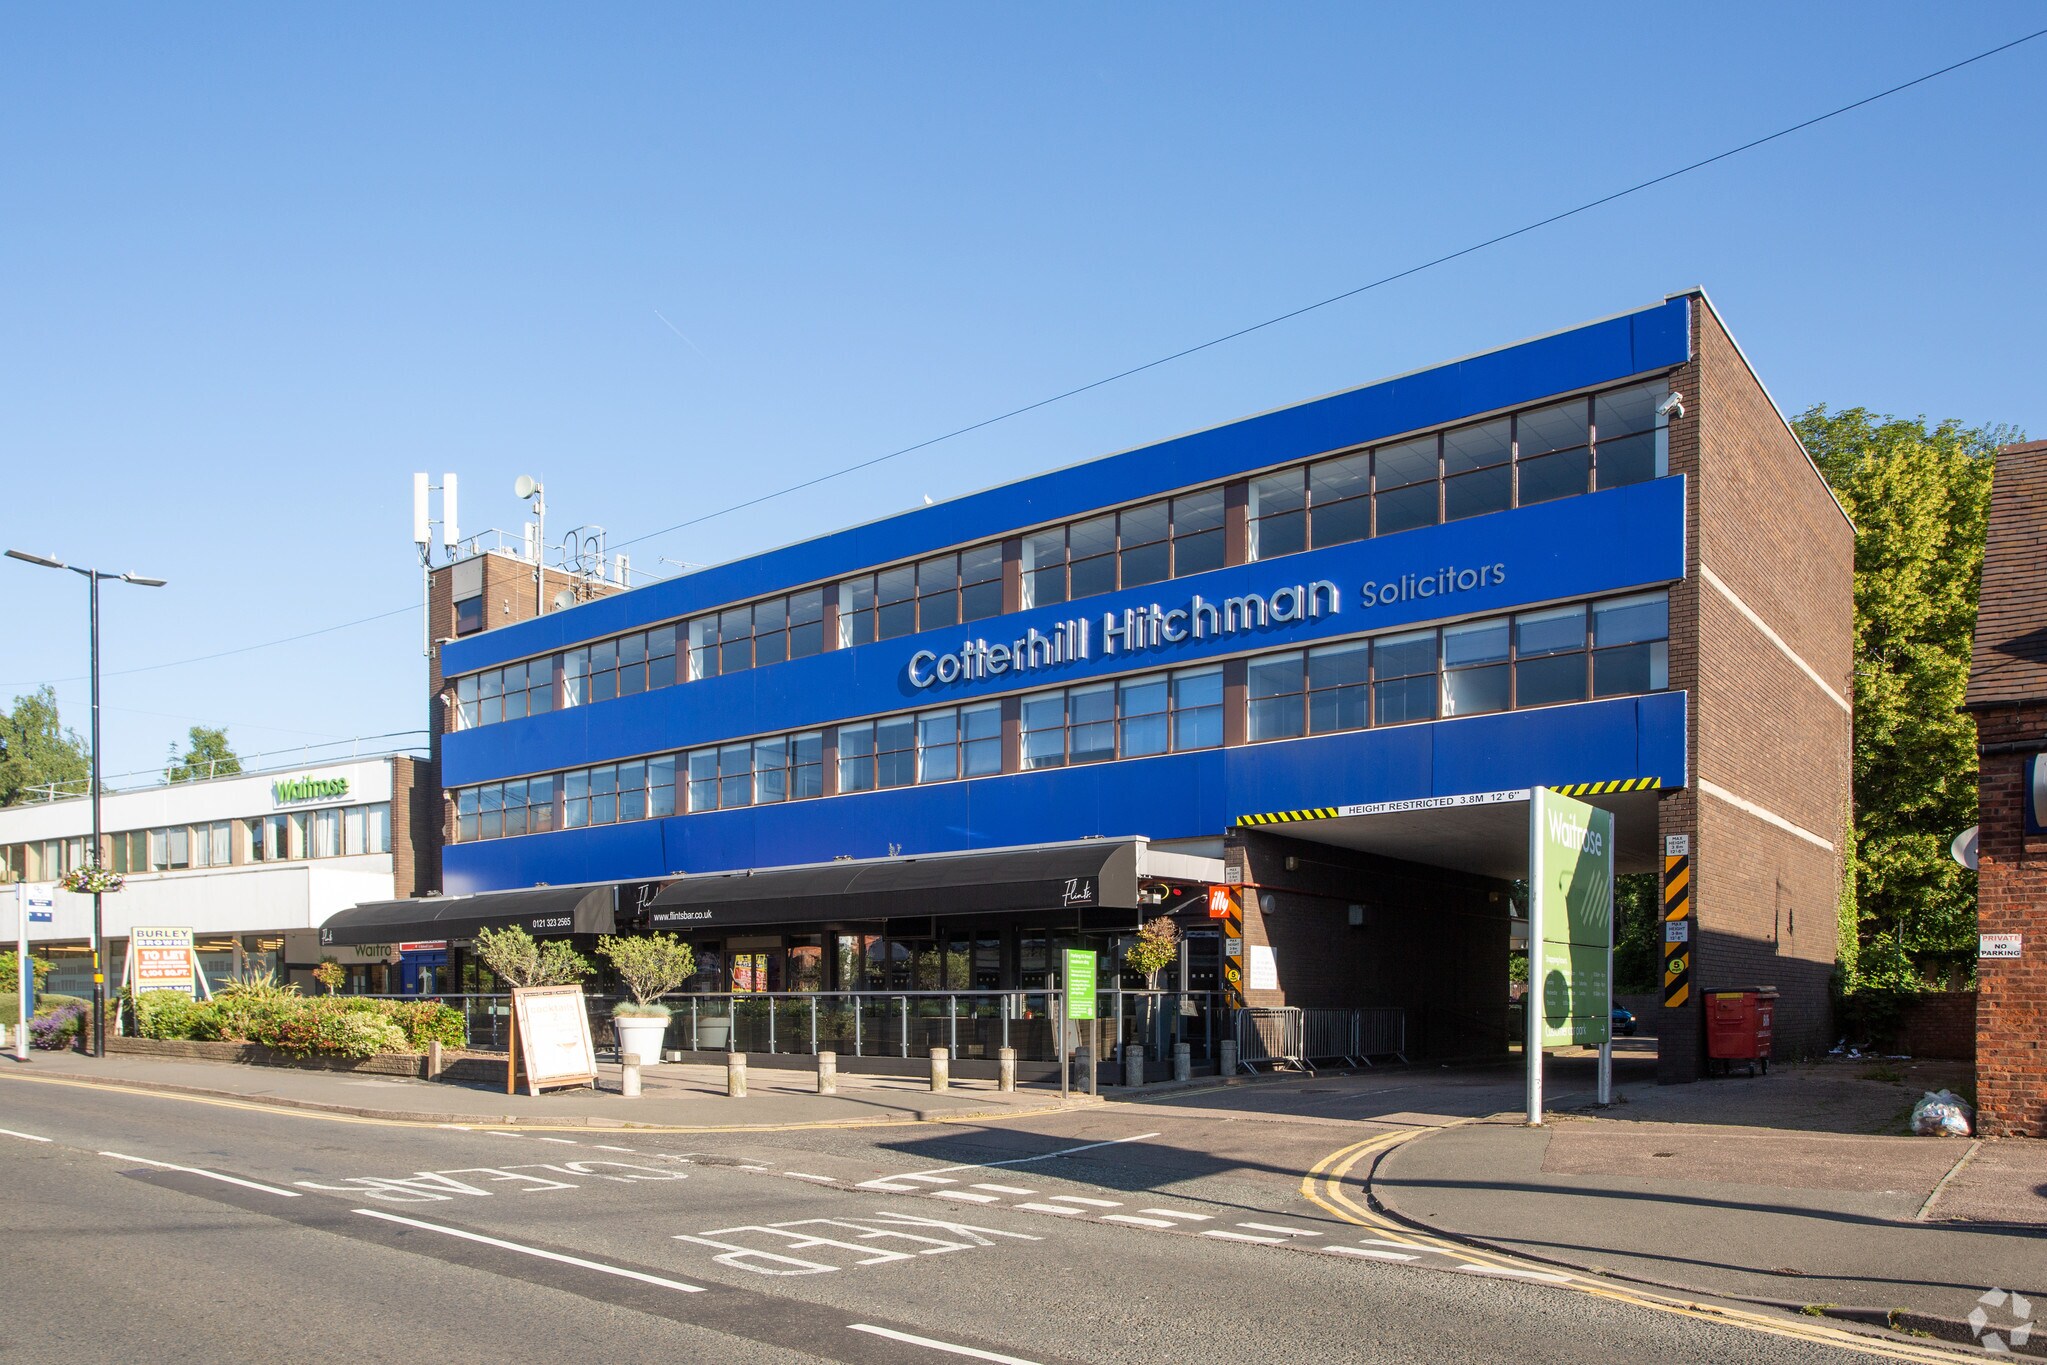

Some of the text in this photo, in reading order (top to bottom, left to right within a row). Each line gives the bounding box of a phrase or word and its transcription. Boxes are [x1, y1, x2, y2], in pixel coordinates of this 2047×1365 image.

[1362, 563, 1505, 607] Solicitors
[908, 580, 1339, 688] Cotterhill Hitchman
[275, 774, 349, 802] Waitrose
[1348, 804, 1386, 815] HEIGHT
[1389, 797, 1454, 810] RESTRICTED
[1460, 795, 1484, 804] 3.8M
[1491, 792, 1505, 801] 12'
[1548, 808, 1602, 856] Waitrose
[1211, 890, 1229, 915] illy
[532, 918, 571, 928] 0121 323 2565
[653, 909, 712, 921] www.flintsbar.co.uk
[142, 950, 186, 960] TO LET
[1674, 960, 1680, 968] 5
[1545, 1023, 1567, 1037] Customer
[1576, 1023, 1587, 1038] park
[671, 1211, 1046, 1275] KEEP
